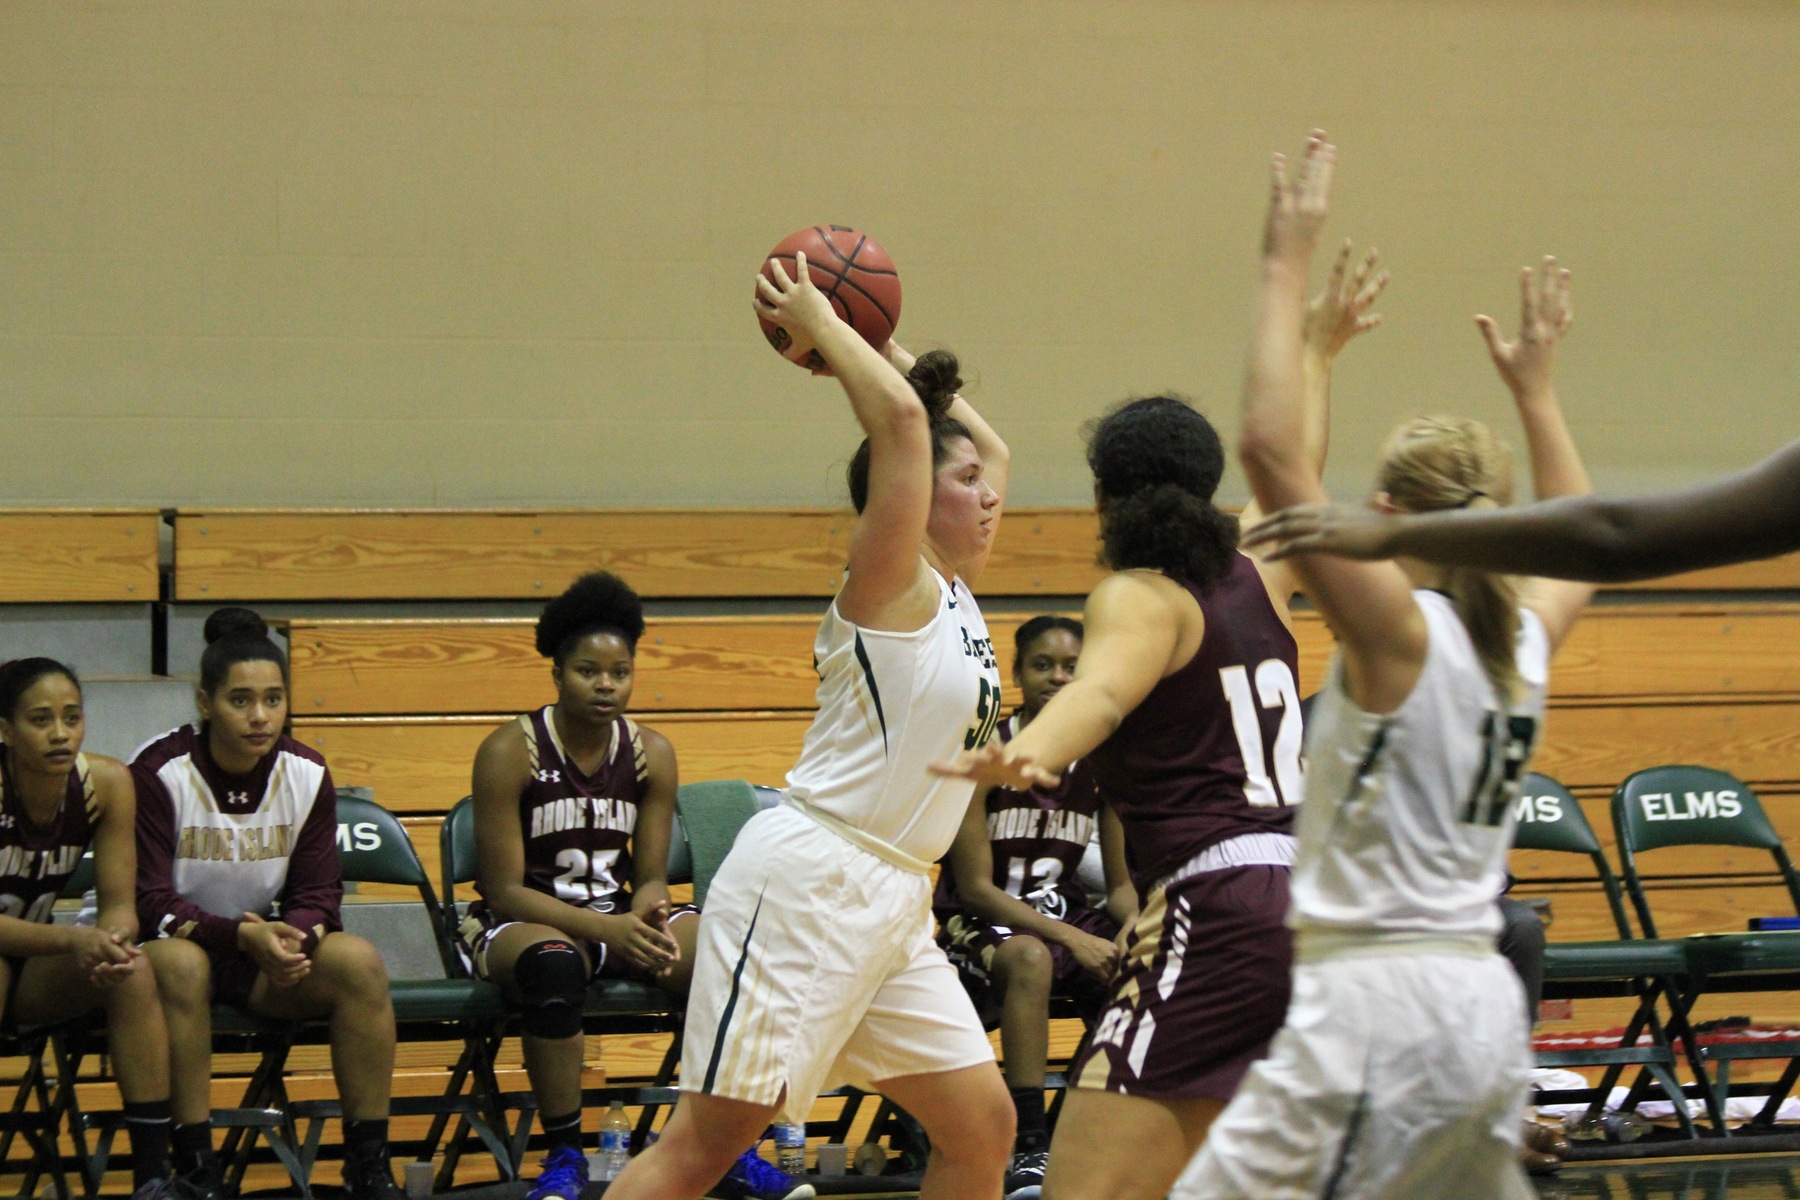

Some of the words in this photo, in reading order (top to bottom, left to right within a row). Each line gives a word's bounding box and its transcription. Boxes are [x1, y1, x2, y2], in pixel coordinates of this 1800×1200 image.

[1218, 657, 1309, 807] 12
[531, 797, 587, 838] RHODE
[592, 798, 638, 835] ISLAN
[1515, 795, 1563, 822] MS
[1640, 790, 1743, 821] ELMS
[238, 824, 293, 861] ISLAN
[336, 822, 382, 851] MS
[1042, 809, 1093, 848] ISLAN
[553, 848, 620, 899] 25
